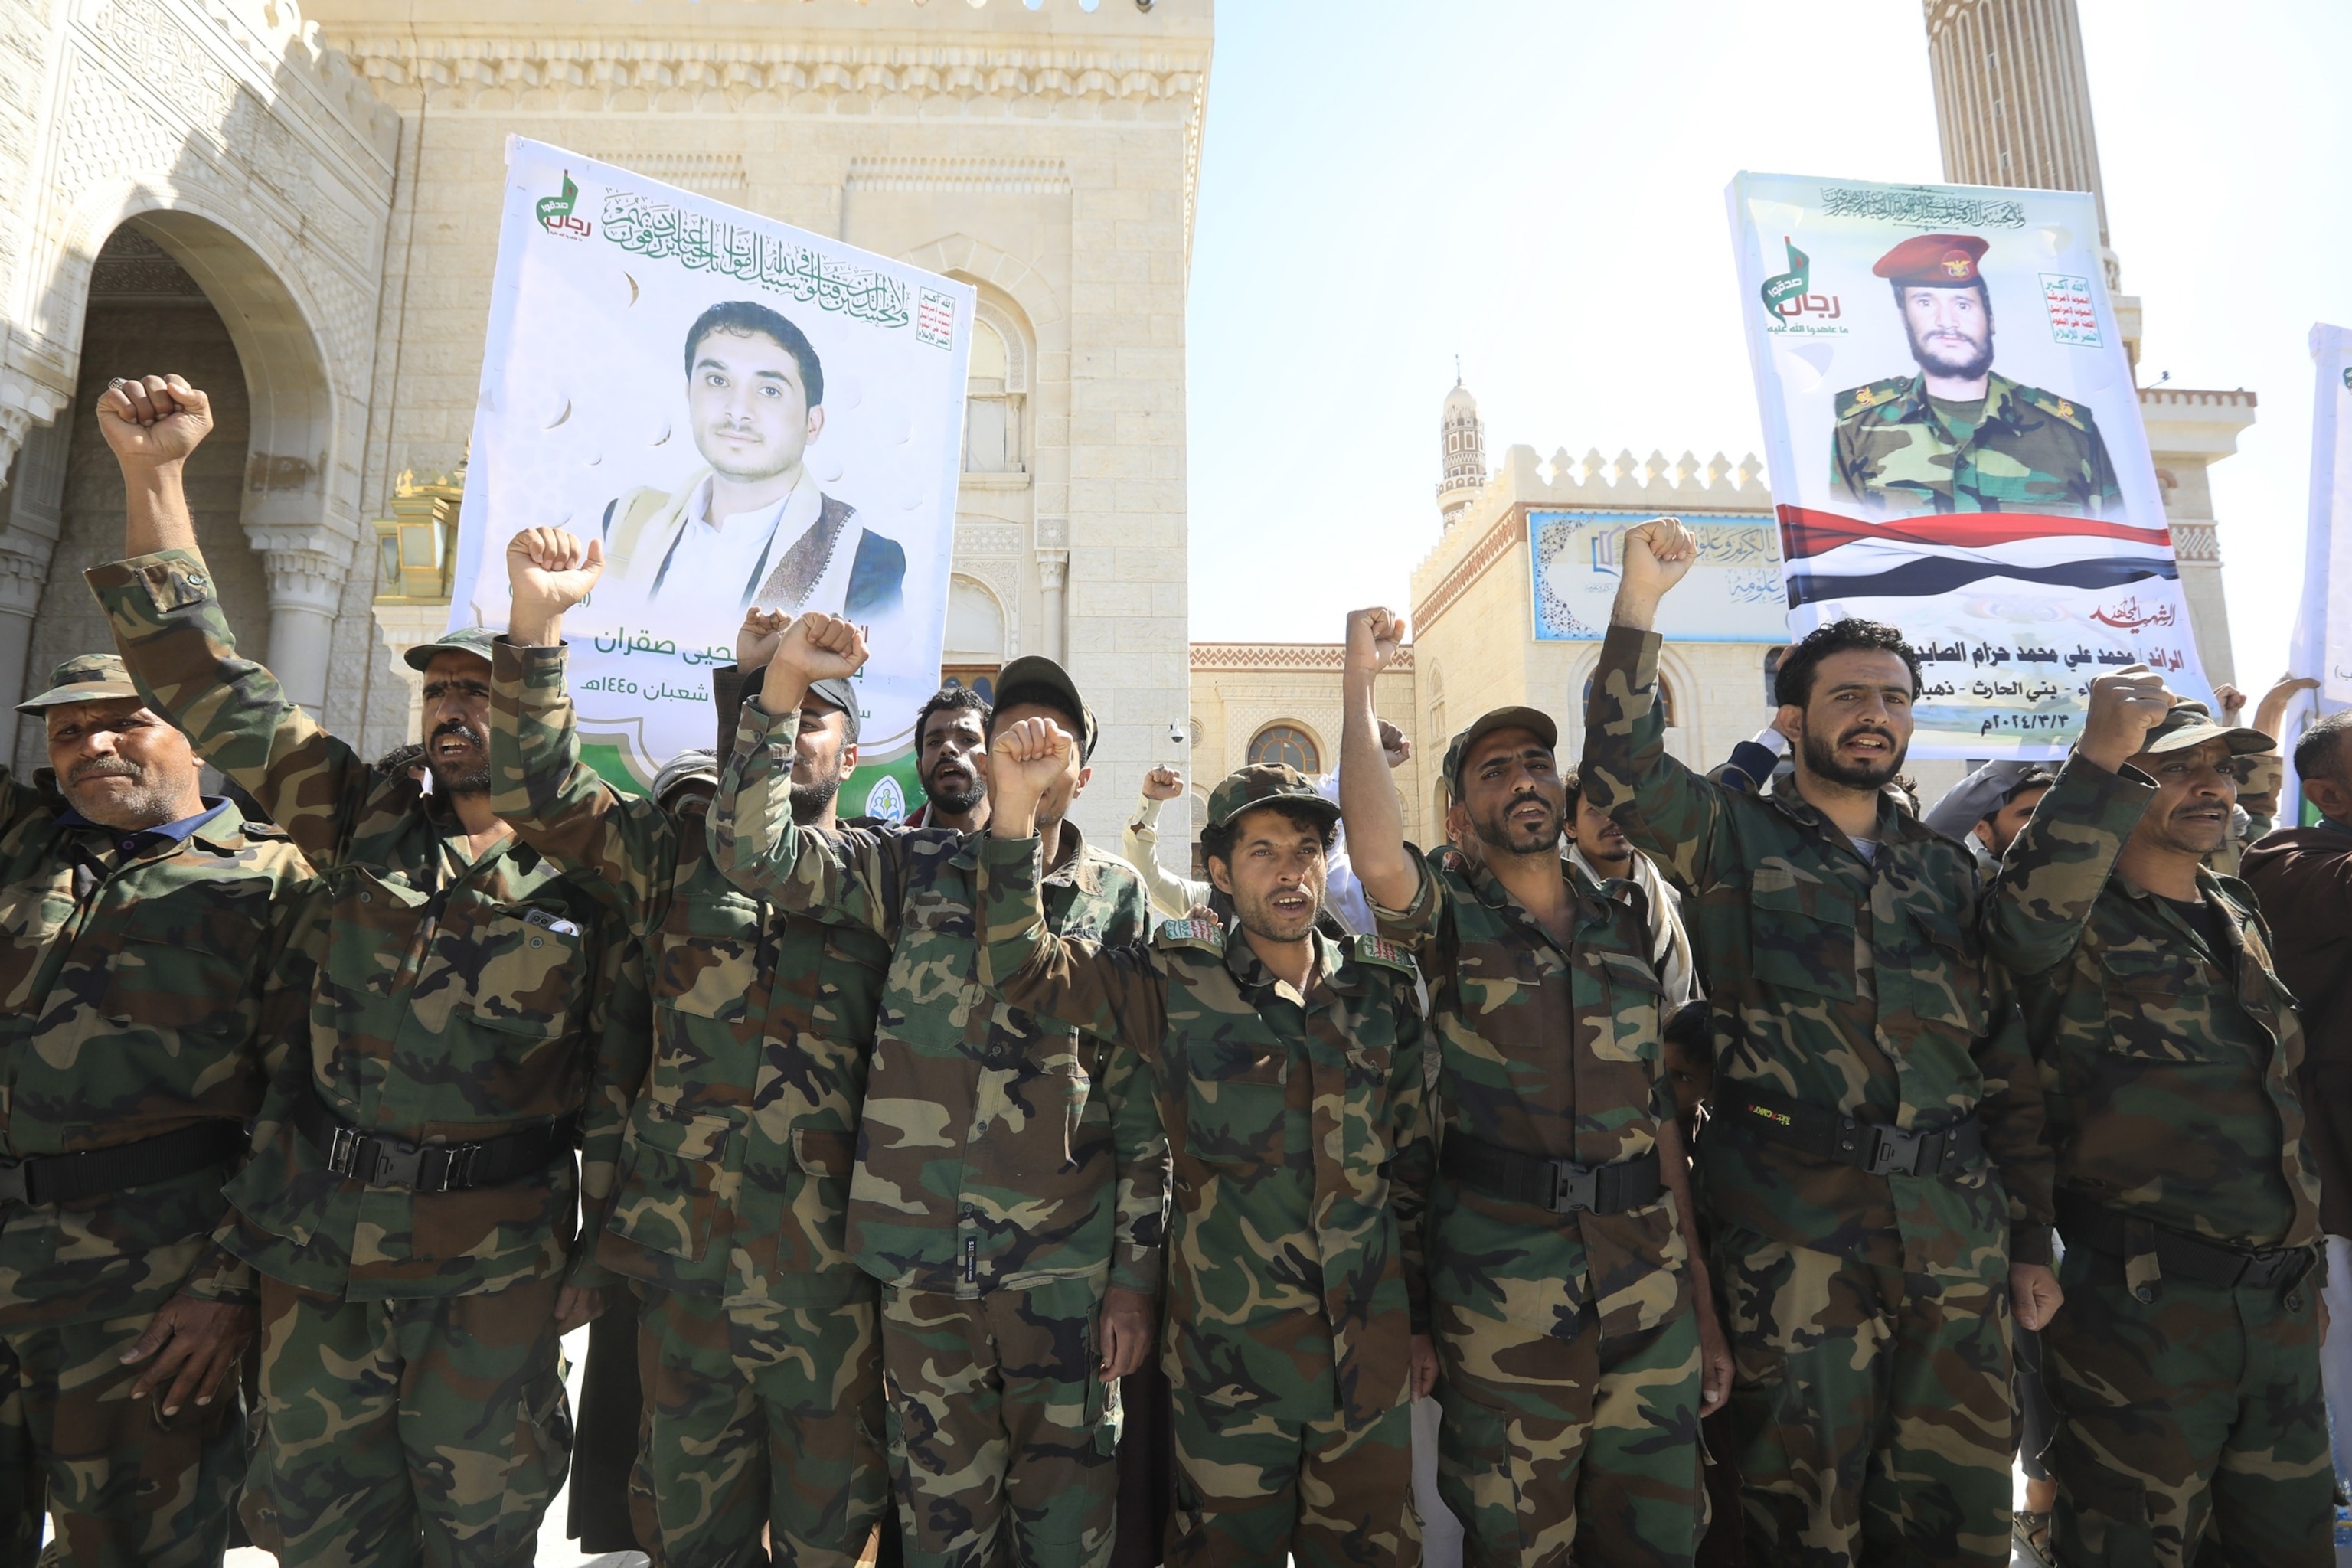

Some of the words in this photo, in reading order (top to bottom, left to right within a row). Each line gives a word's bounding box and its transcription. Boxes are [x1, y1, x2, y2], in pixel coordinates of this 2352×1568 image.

[541, 200, 569, 213] صدقوا
[546, 214, 591, 237] رجال
[1767, 277, 1802, 297] صدقوا
[1778, 293, 1841, 318] رجال
[1767, 324, 1787, 335] عليه
[1789, 322, 1805, 332] الله
[1806, 325, 1838, 335] عاهدوا
[594, 627, 675, 655] صقران
[682, 646, 738, 665] حيى
[1971, 641, 2011, 669] حزام
[2016, 646, 2058, 663] محمد
[2064, 644, 2092, 672] علي
[2097, 648, 2135, 665] محمد
[2148, 647, 2184, 673] الرائد
[643, 683, 708, 702] شعبان
[1920, 681, 1955, 701] ذهبا
[1972, 680, 2023, 699] الحارث
[2026, 681, 2057, 702] بني
